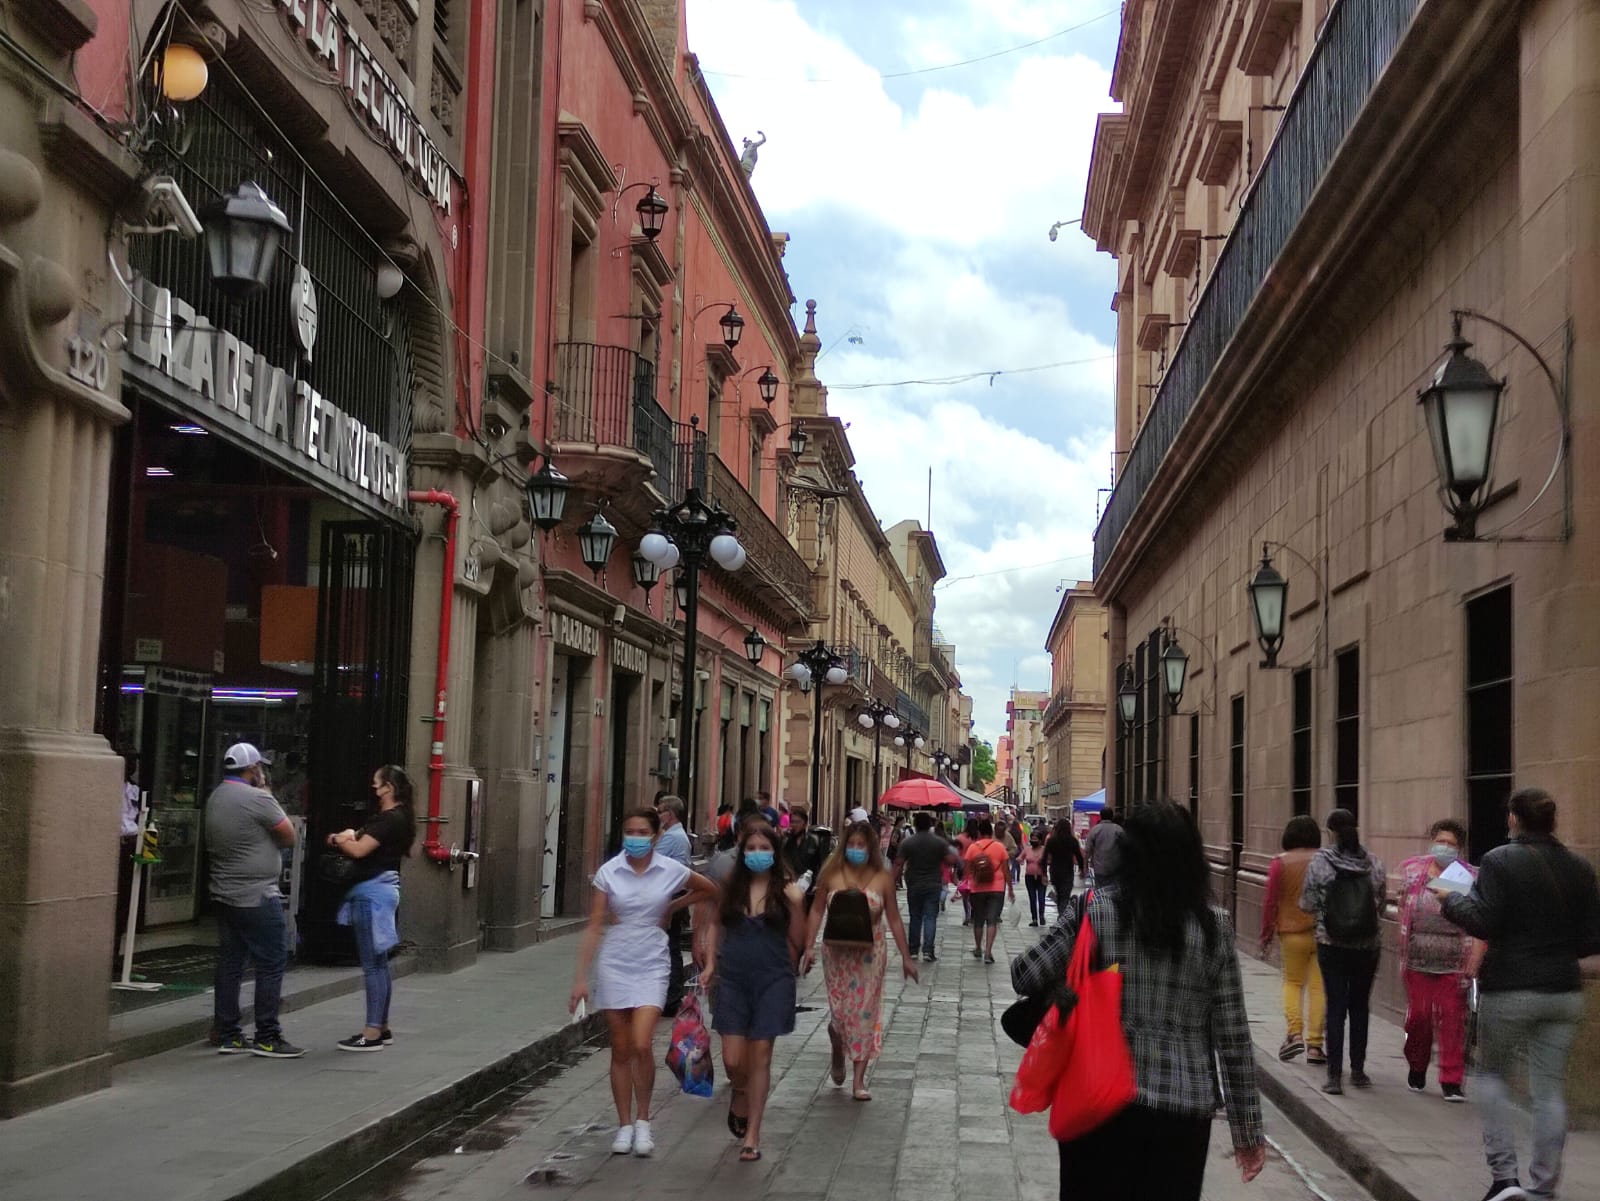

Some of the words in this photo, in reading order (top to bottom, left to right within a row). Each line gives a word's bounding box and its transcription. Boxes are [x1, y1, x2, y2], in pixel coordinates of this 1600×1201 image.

[307, 0, 340, 71] LA
[67, 337, 108, 391] 120
[126, 264, 215, 400] LAZA
[214, 329, 254, 423] DE
[252, 354, 290, 446] LA
[561, 614, 583, 651] PLAZA
